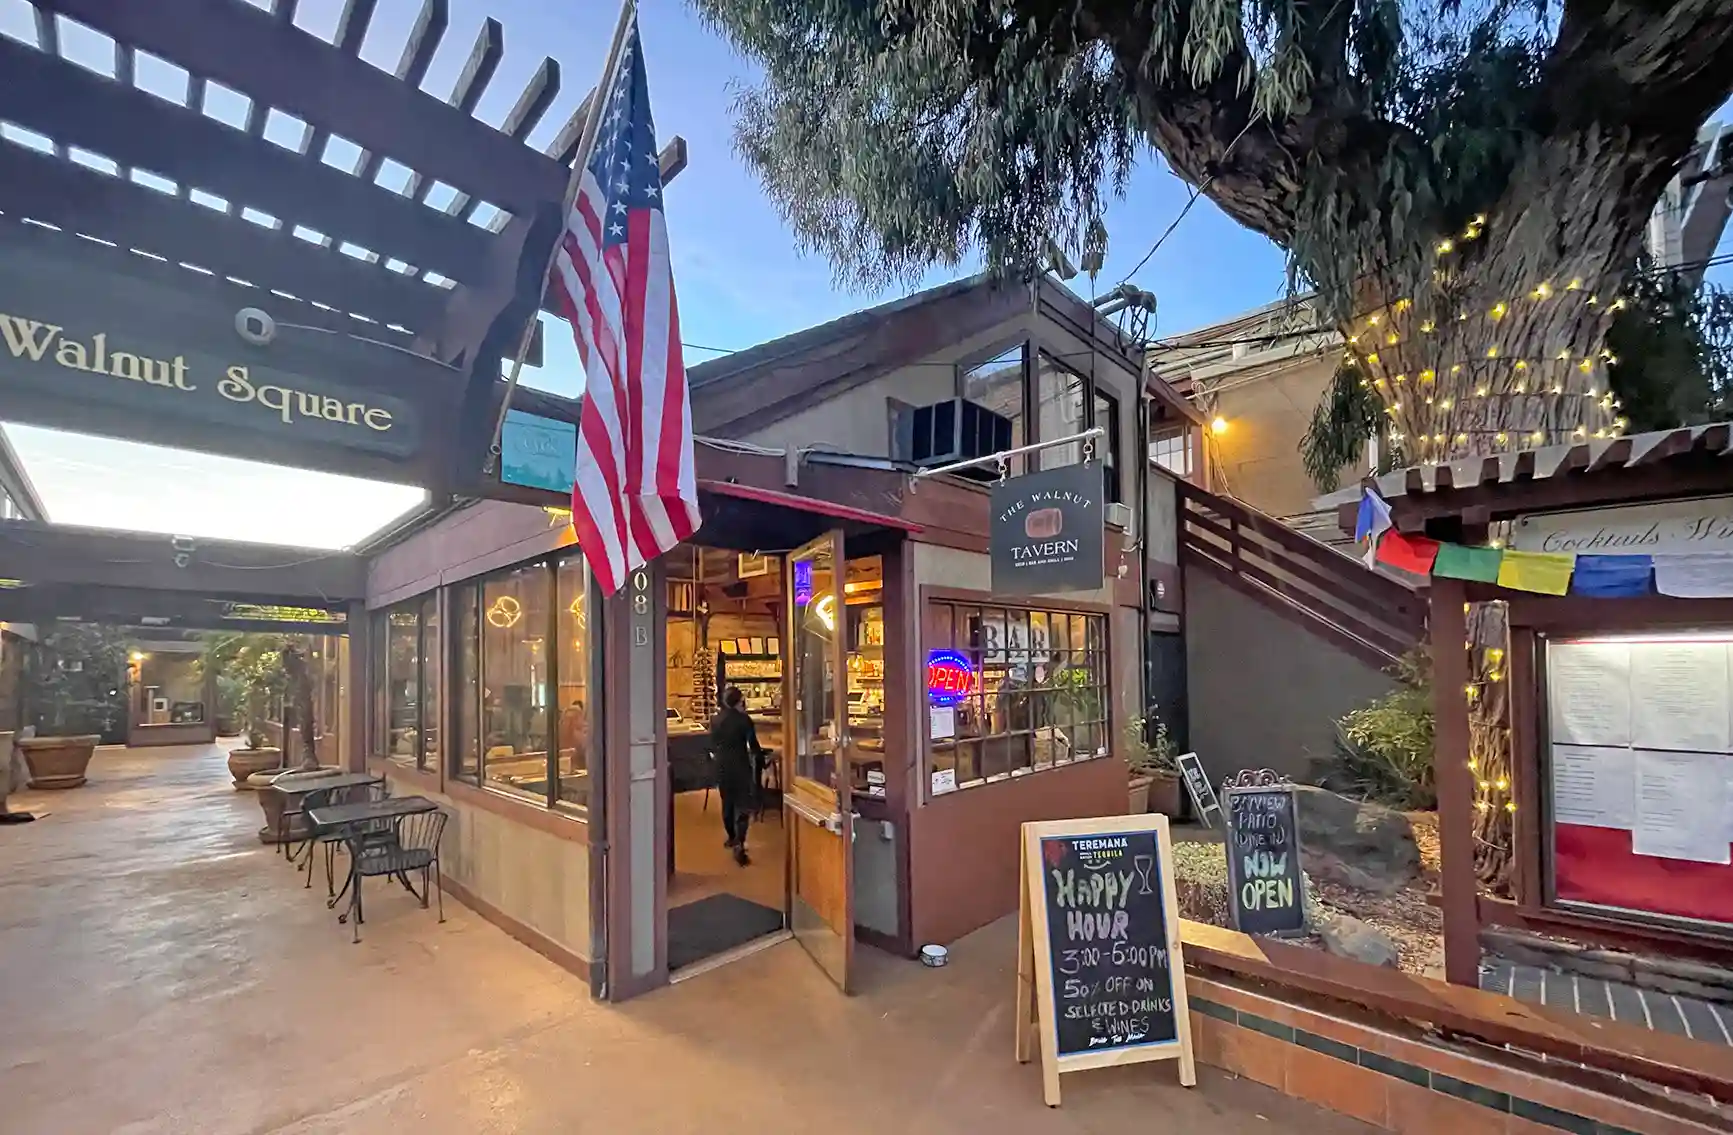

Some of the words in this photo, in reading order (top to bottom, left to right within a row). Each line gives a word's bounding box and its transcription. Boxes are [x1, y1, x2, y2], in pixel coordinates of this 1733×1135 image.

[0, 313, 197, 391] Walnut
[217, 365, 393, 431] Square
[1000, 499, 1025, 523] THE
[1031, 490, 1092, 509] WALNUT
[1010, 538, 1079, 560] TAVERN
[635, 626, 648, 647] B
[982, 624, 1049, 659] BAR
[1239, 812, 1277, 829] PATIO
[1071, 837, 1129, 851] TEREMANA
[1243, 850, 1287, 879] NOW
[1241, 878, 1293, 911] OPEN
[1067, 910, 1129, 941] HOUR
[1105, 976, 1131, 993] OFF
[1136, 977, 1154, 993] ON
[1131, 997, 1172, 1015] DRINKS
[1105, 1016, 1149, 1035] WINES
